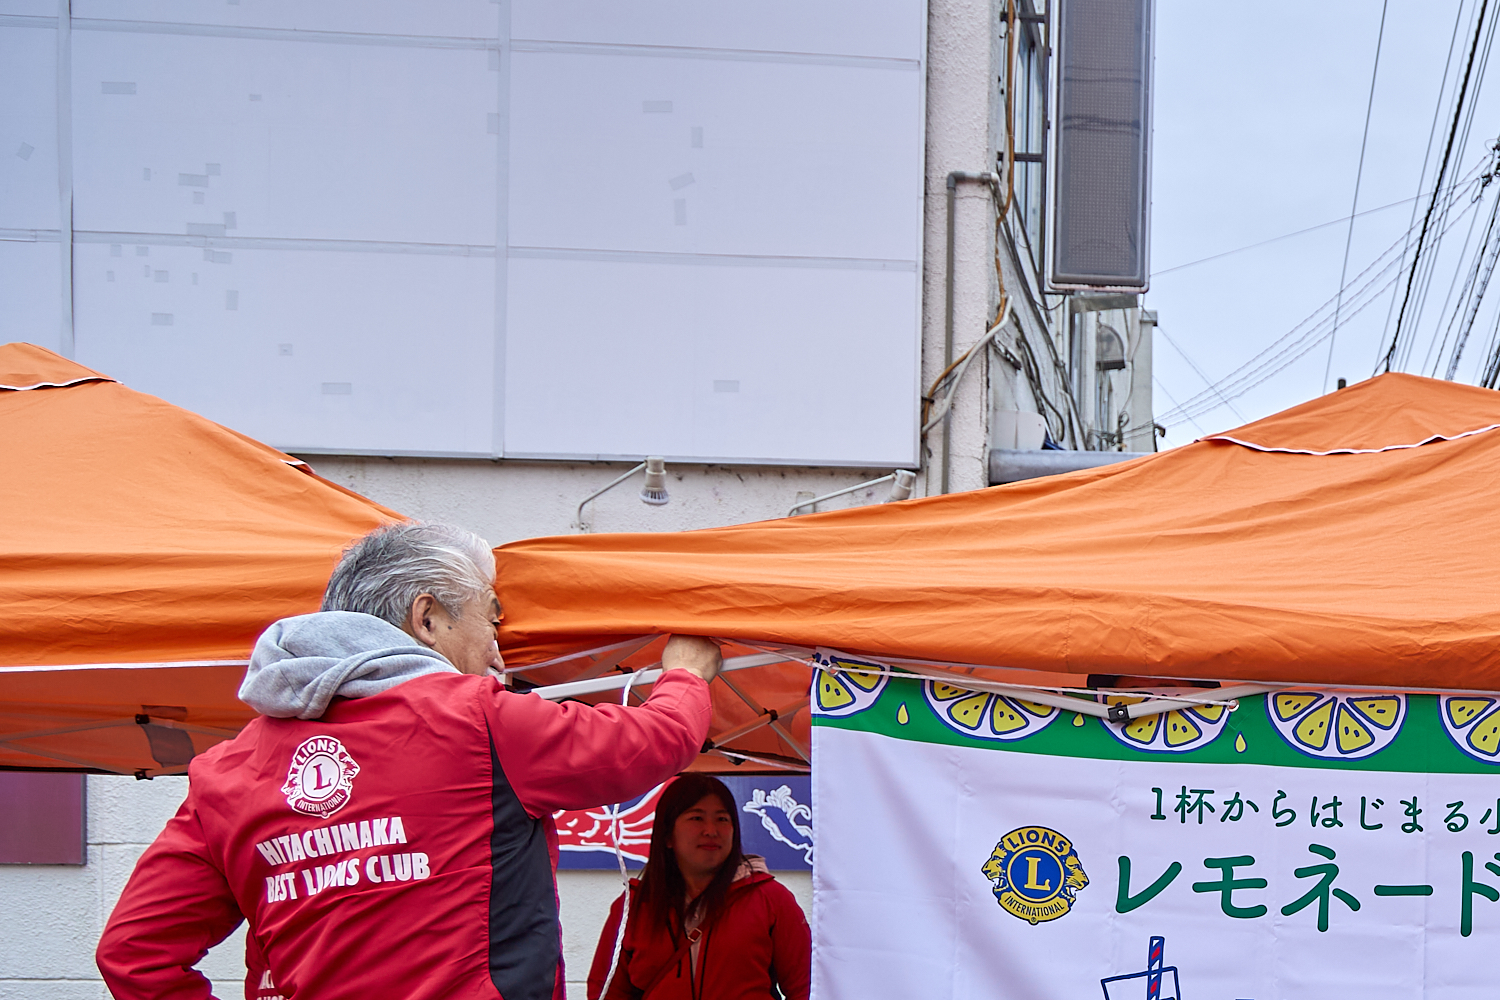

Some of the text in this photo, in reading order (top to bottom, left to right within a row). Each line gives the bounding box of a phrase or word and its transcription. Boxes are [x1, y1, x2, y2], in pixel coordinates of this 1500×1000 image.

[296, 738, 338, 766] LIONS
[312, 763, 333, 791] L
[296, 791, 346, 813] INTERNATIONAL
[255, 816, 408, 867] HITACHINAKA
[1006, 829, 1068, 854] LIONS
[265, 852, 431, 904] BEST LIONS CLUB
[1023, 856, 1052, 892] L
[1003, 894, 1065, 918] INTERNATIONAL
